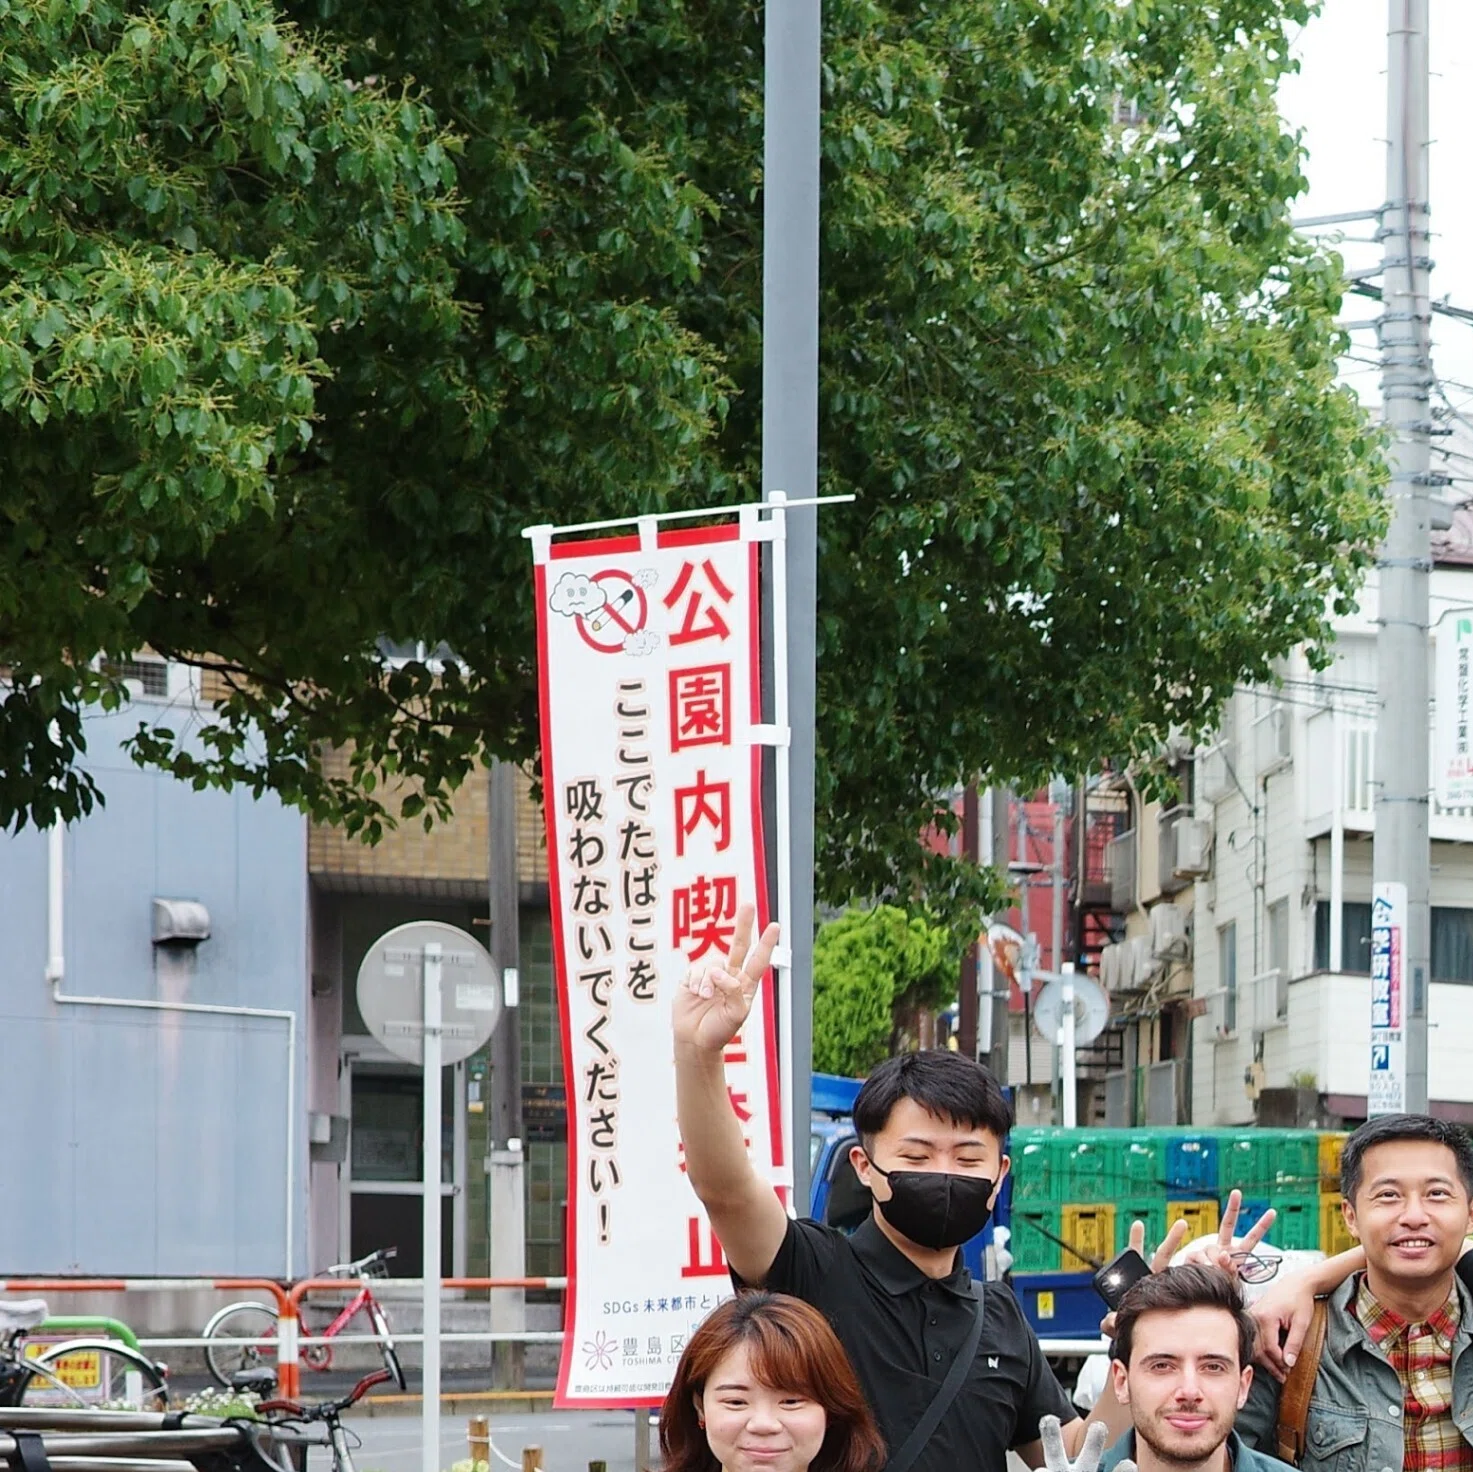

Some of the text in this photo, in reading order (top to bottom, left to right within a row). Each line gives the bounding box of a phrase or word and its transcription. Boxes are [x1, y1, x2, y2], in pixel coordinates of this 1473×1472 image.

[616, 681, 657, 1000] ここでたばこを
[664, 559, 752, 1277] 公園内喫止
[622, 1335, 684, 1356] 豊島区
[622, 1357, 662, 1367] TOSHIMA
